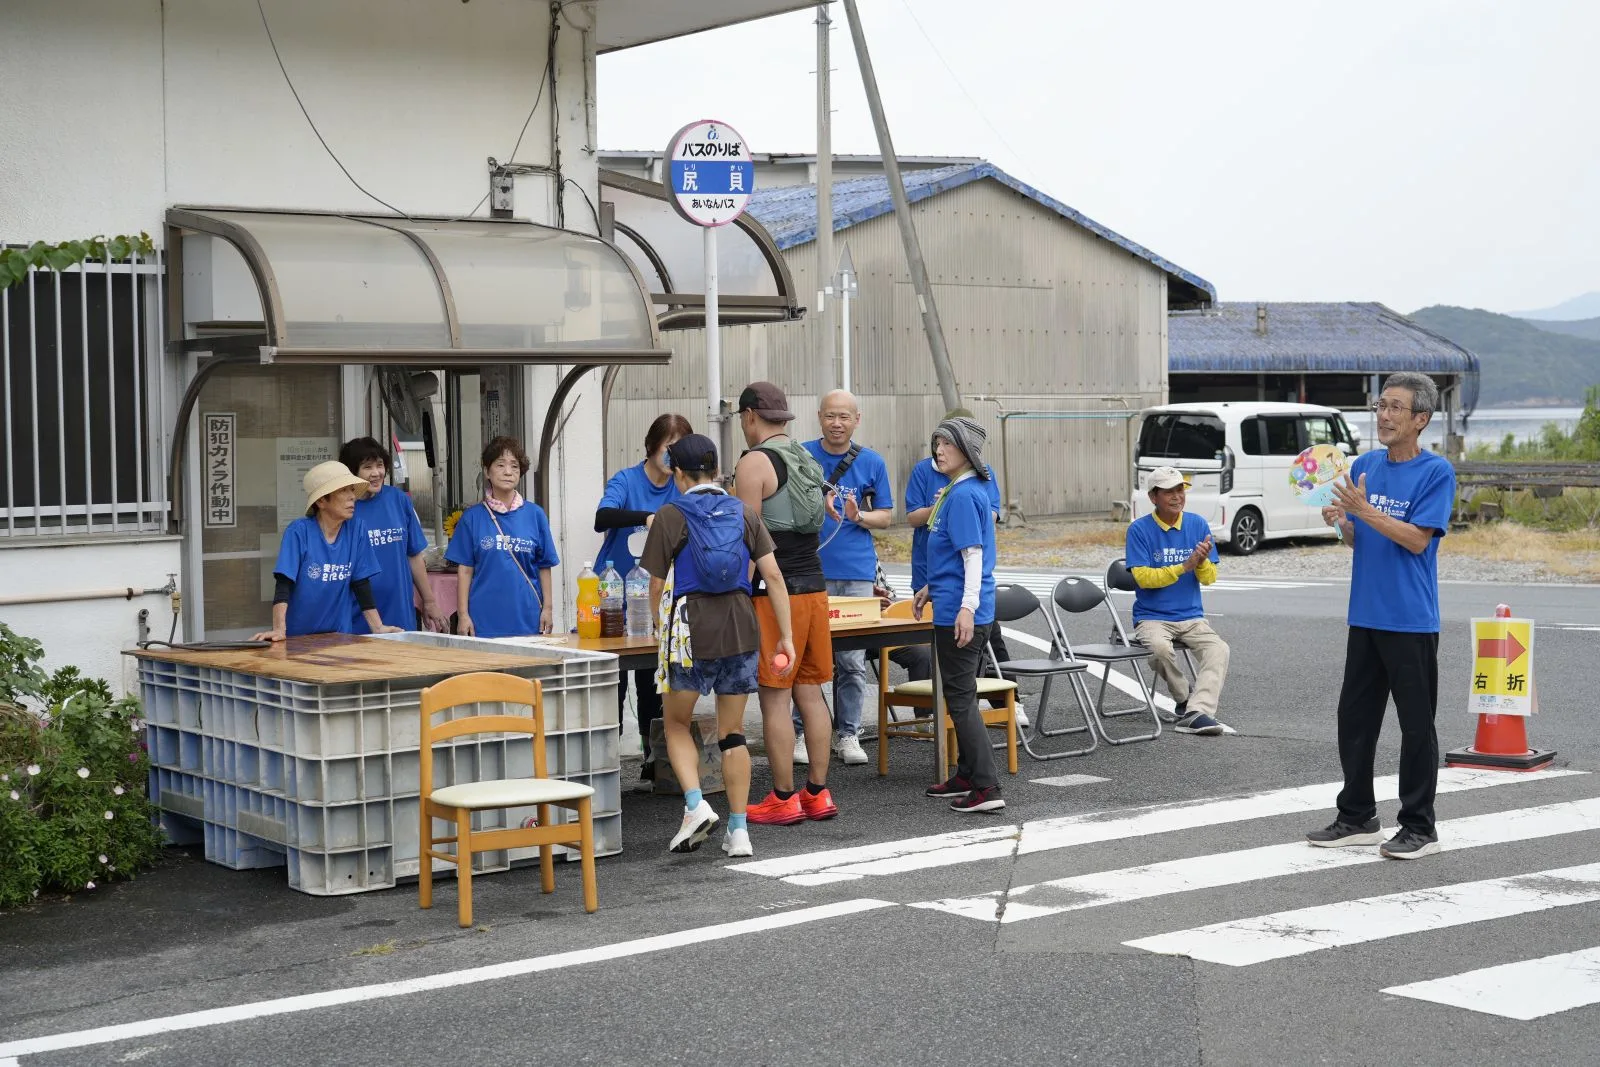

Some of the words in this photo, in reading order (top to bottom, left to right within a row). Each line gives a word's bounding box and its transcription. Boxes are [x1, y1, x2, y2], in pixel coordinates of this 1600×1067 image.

[682, 142, 742, 157] バスのりば
[691, 198, 735, 209] あいなんバス
[208, 418, 231, 522] 防犯カメラ作動中
